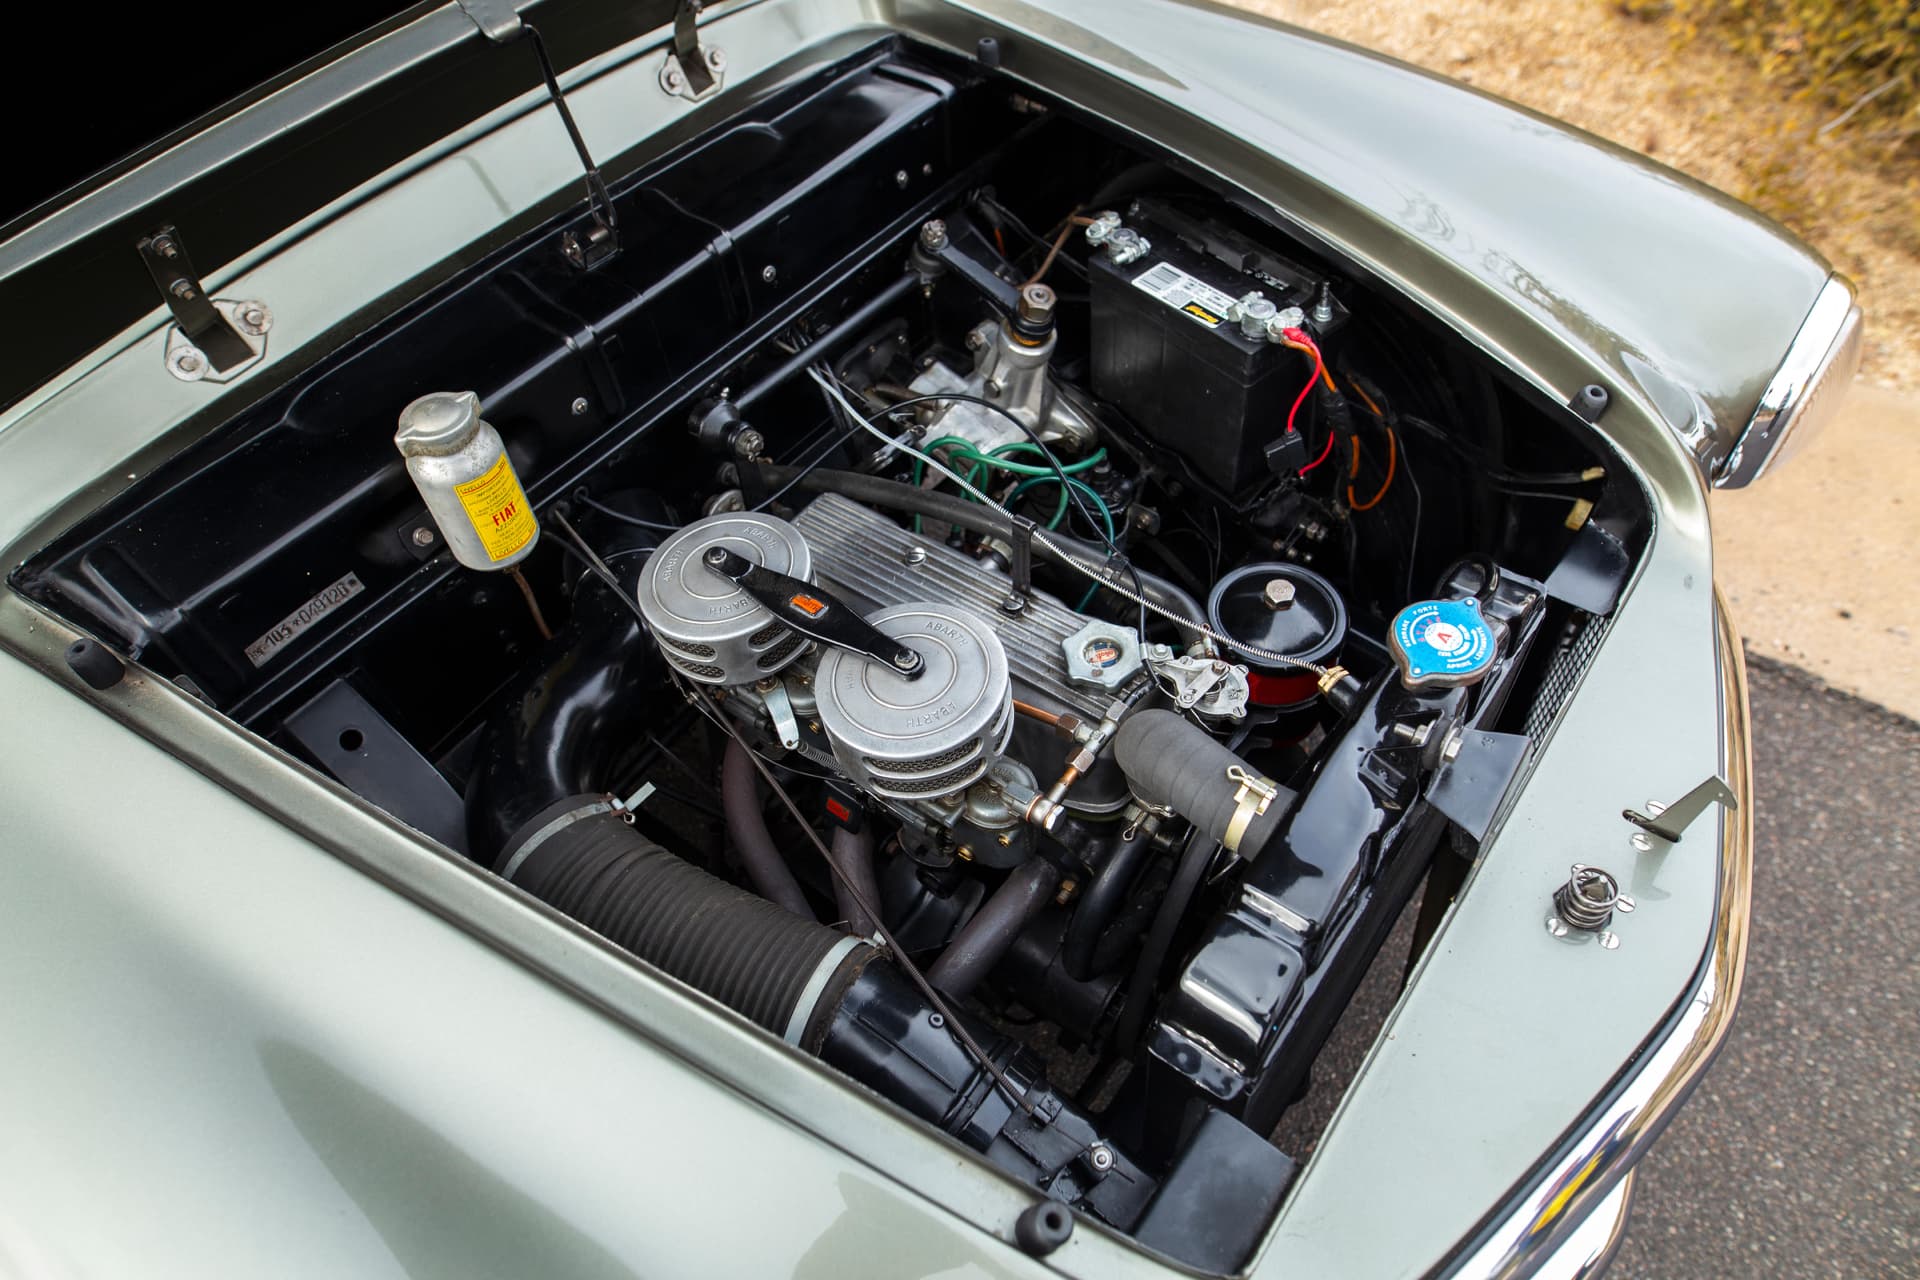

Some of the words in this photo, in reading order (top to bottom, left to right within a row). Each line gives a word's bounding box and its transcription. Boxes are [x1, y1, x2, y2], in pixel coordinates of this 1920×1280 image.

[492, 501, 517, 527] FIAT
[1412, 605, 1439, 616] FORTE
[926, 621, 969, 647] ABARTH
[906, 701, 957, 728] ABARTH
